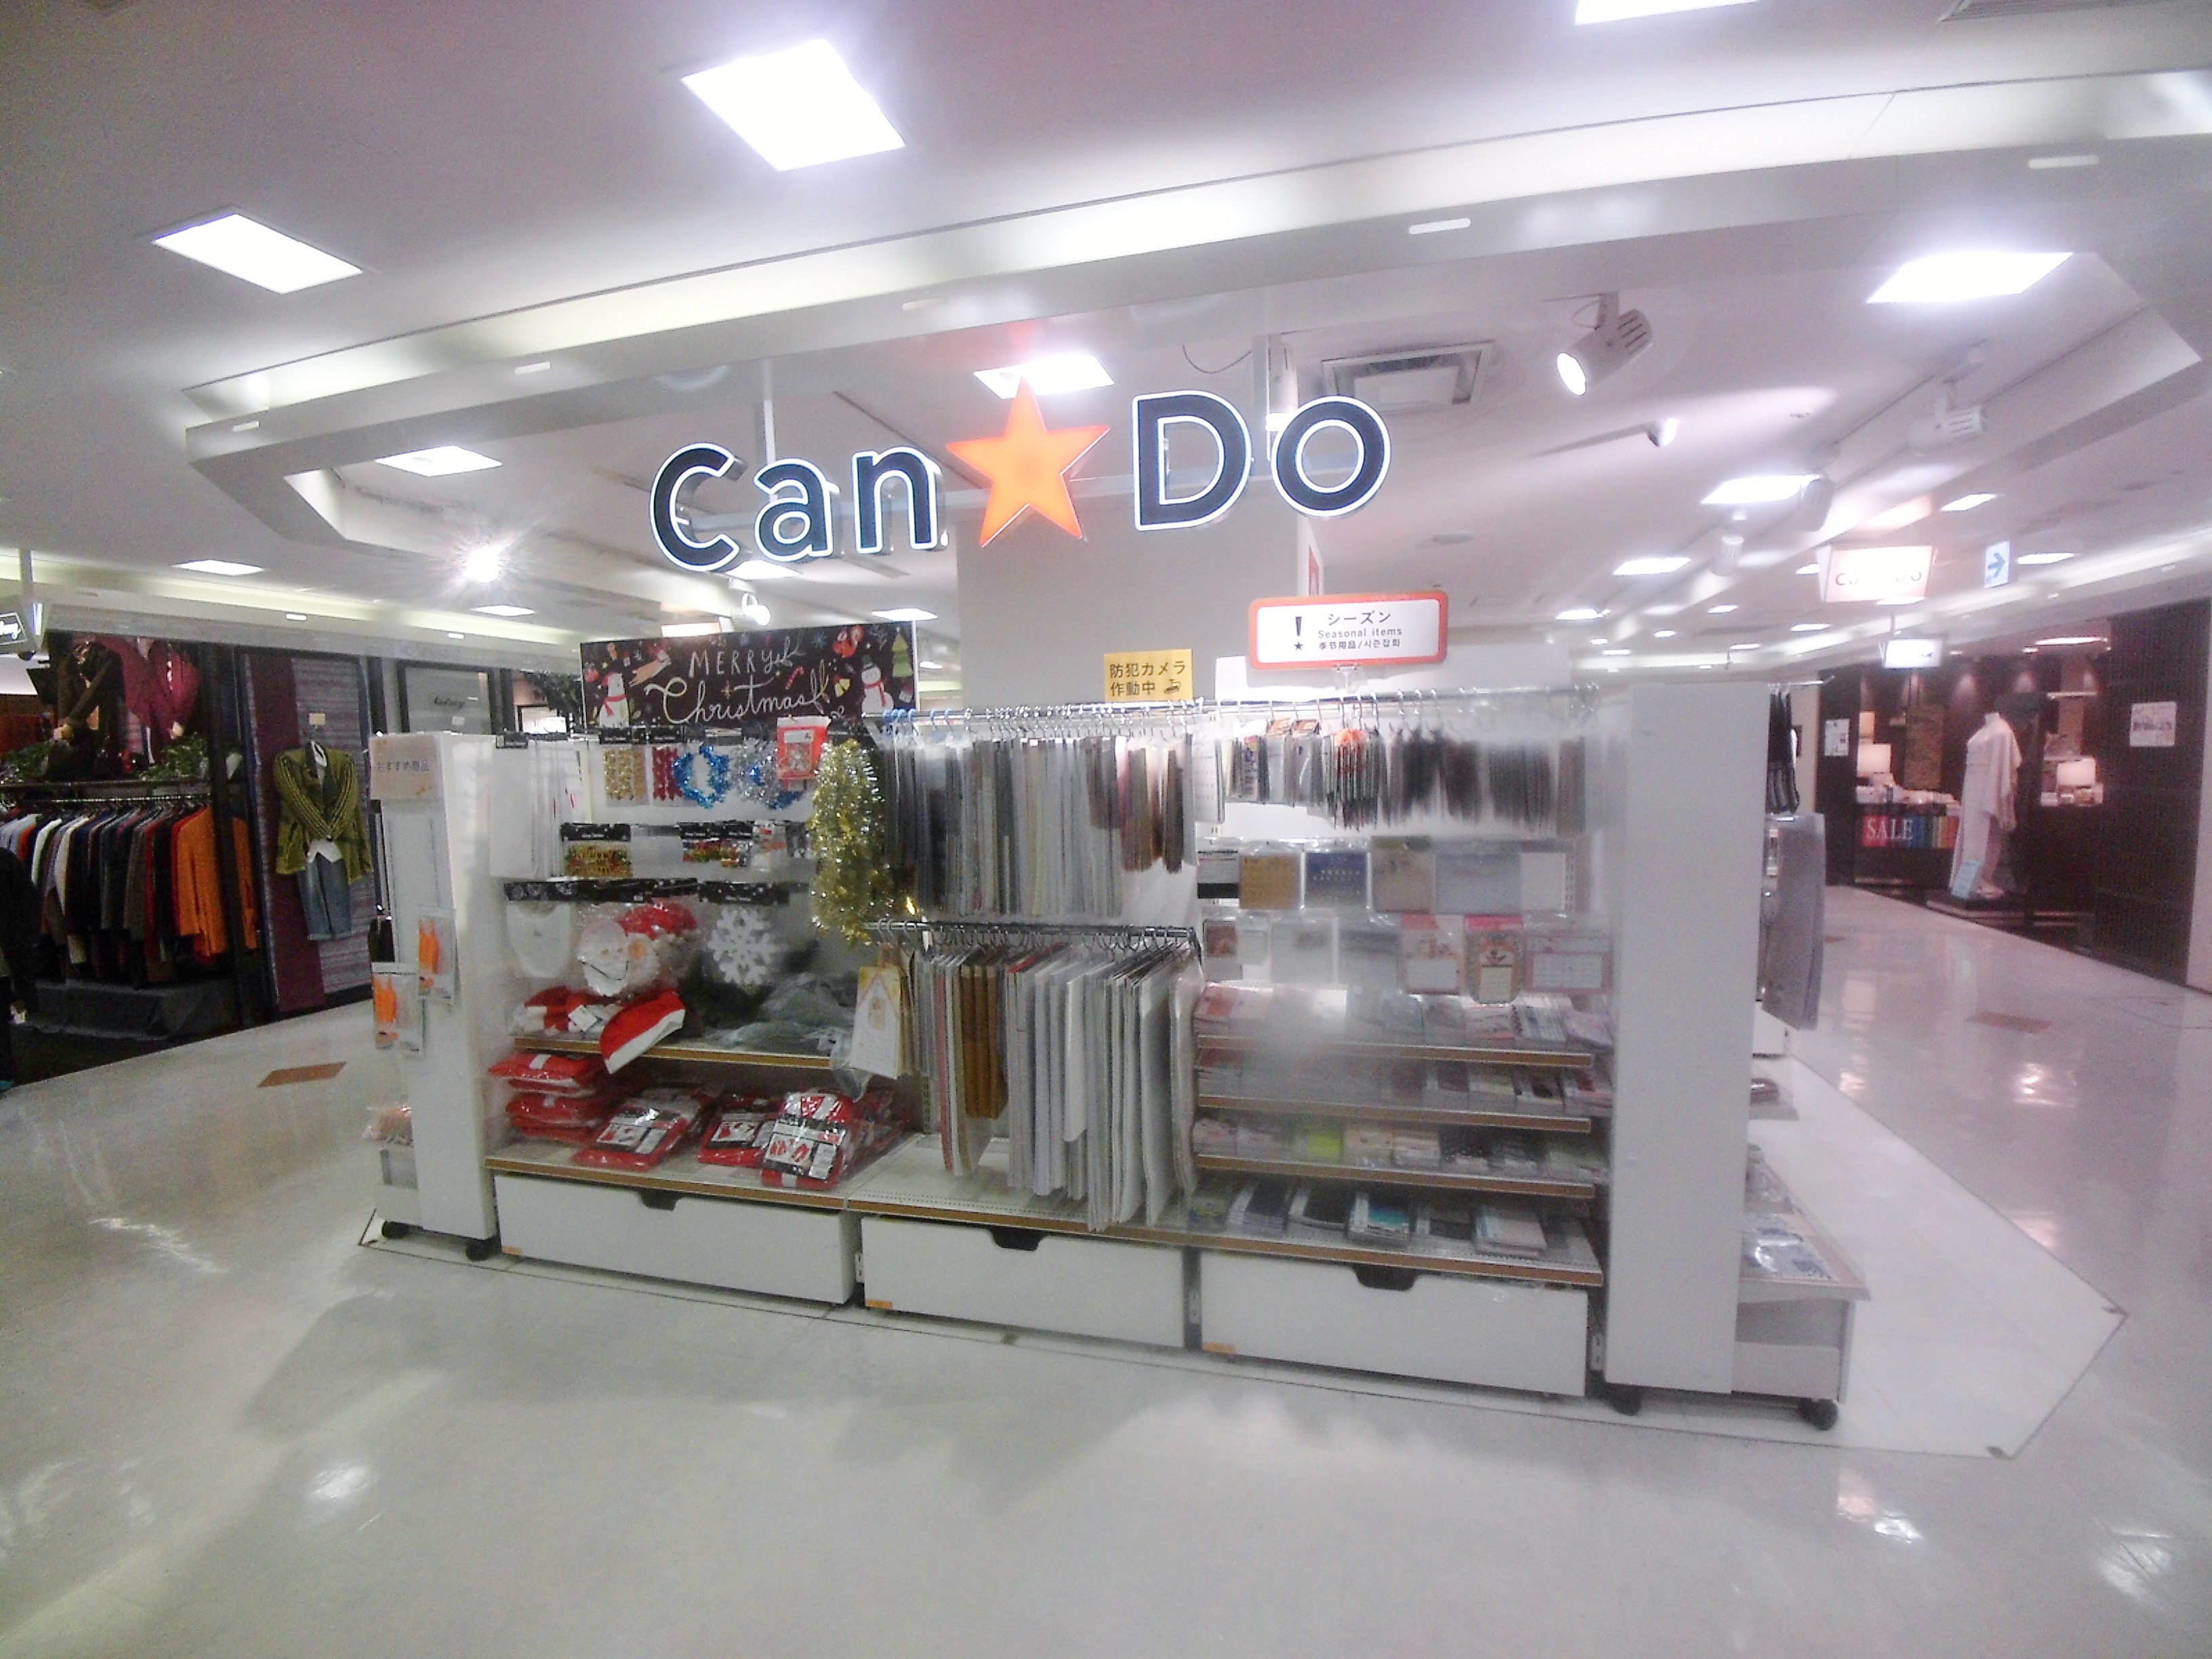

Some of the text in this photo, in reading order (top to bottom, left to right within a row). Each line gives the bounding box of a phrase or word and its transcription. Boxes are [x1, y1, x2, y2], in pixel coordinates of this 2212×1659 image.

[649, 441, 946, 573] Can
[1328, 610, 1391, 626] シーズン
[1317, 628, 1403, 639] Seasonal items
[1109, 660, 1186, 679] 防犯カメラ
[1109, 680, 1155, 697] 作動中
[644, 674, 815, 724] Christmas
[1867, 818, 1913, 840] SALE
